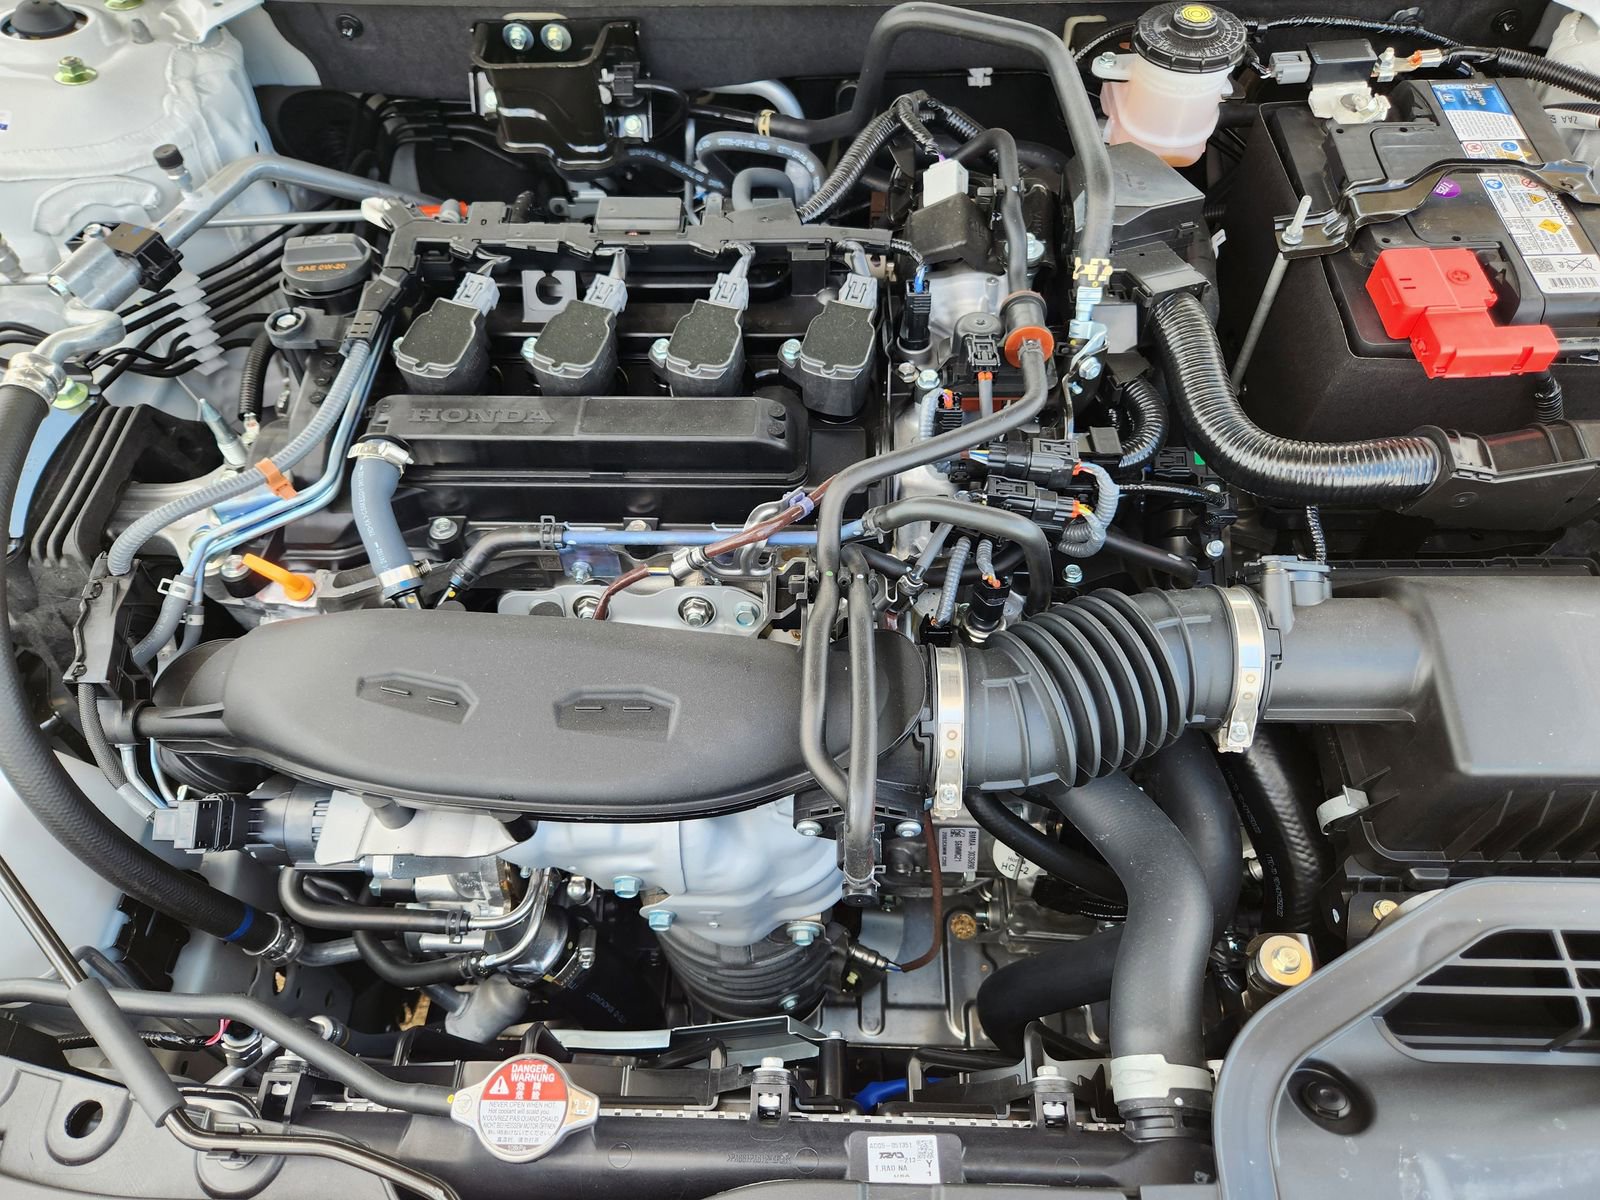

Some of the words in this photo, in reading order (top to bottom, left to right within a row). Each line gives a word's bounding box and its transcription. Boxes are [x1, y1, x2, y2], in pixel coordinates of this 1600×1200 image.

[296, 264, 317, 273] SAE
[409, 407, 556, 424] HONDA
[1001, 862, 1029, 875] HC-2
[511, 1064, 548, 1073] DANGER
[511, 1072, 555, 1083] WARNUNG
[926, 1160, 933, 1168] Y
